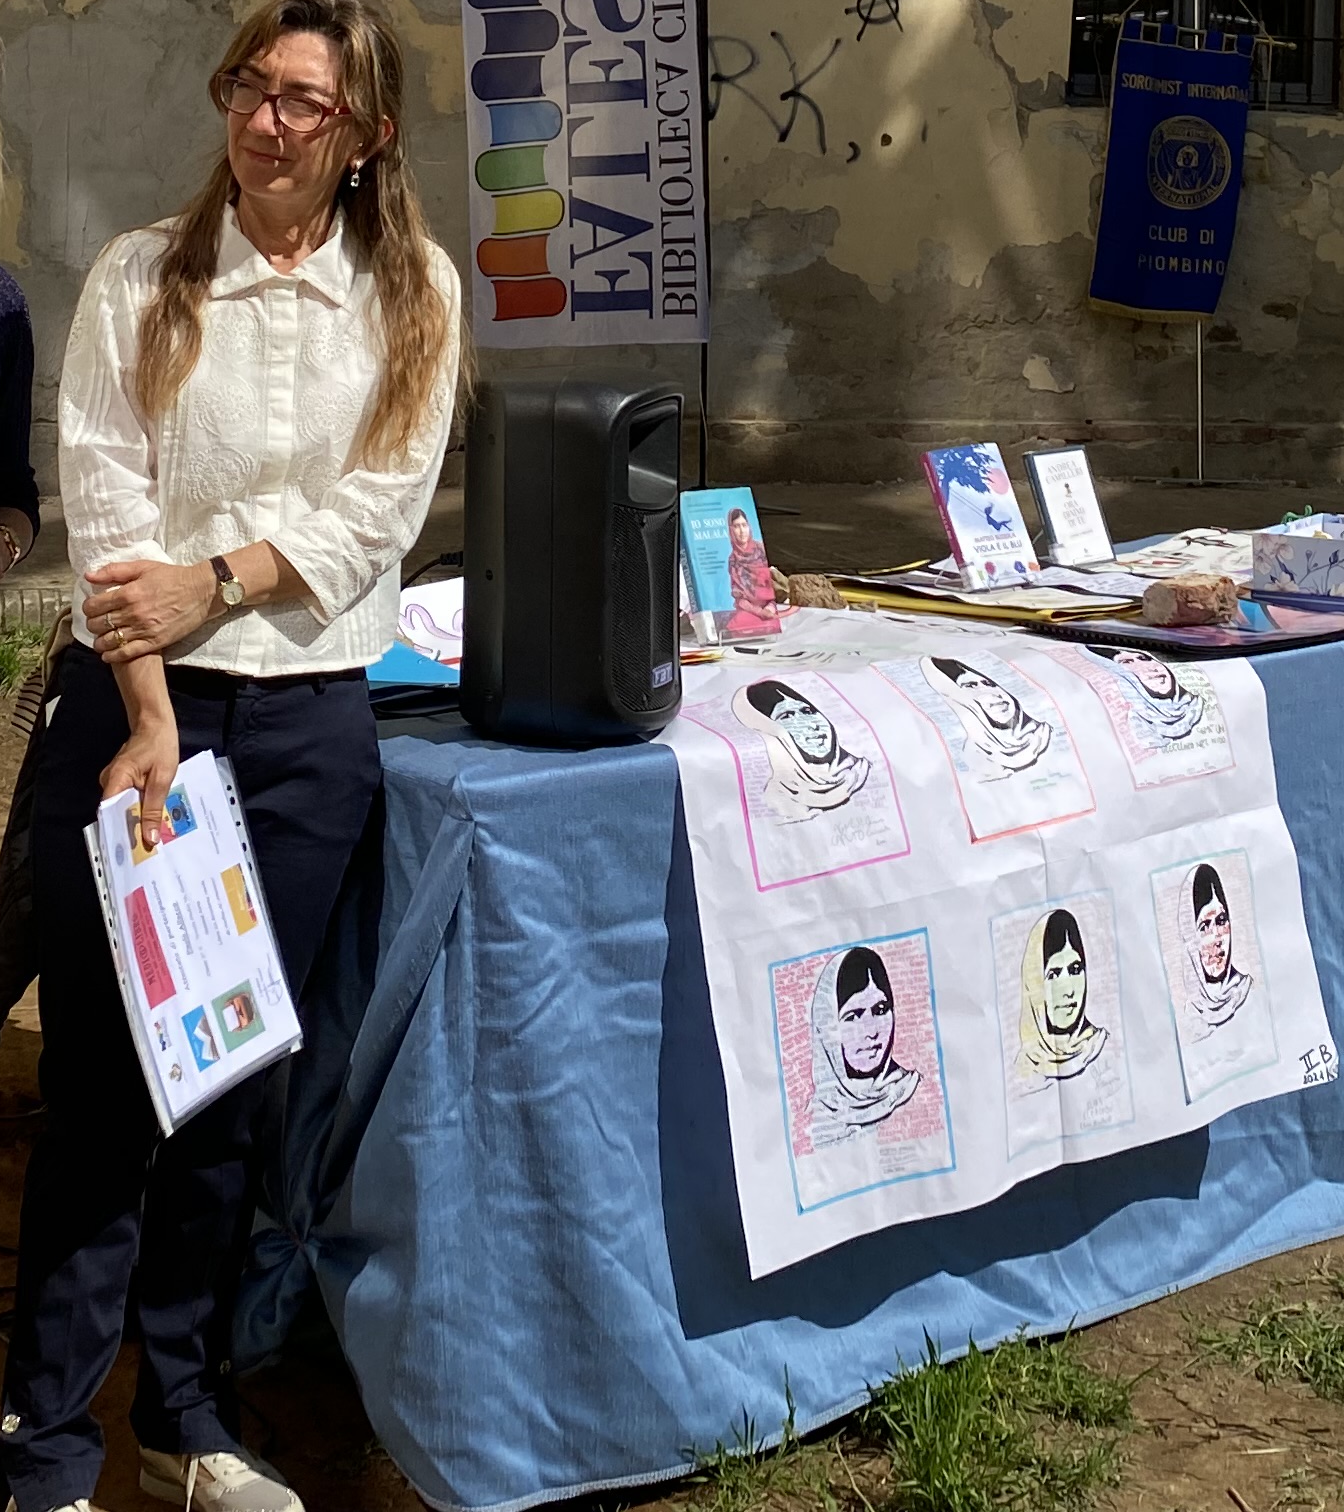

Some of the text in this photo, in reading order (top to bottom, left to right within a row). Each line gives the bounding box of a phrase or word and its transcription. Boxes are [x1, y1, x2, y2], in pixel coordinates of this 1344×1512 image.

[1148, 224, 1215, 245] CLUB DI
[1137, 253, 1225, 276] PIOMBINO
[690, 518, 726, 529] IO SONO
[693, 529, 728, 540] MALALA
[973, 543, 996, 554] VIOLA
